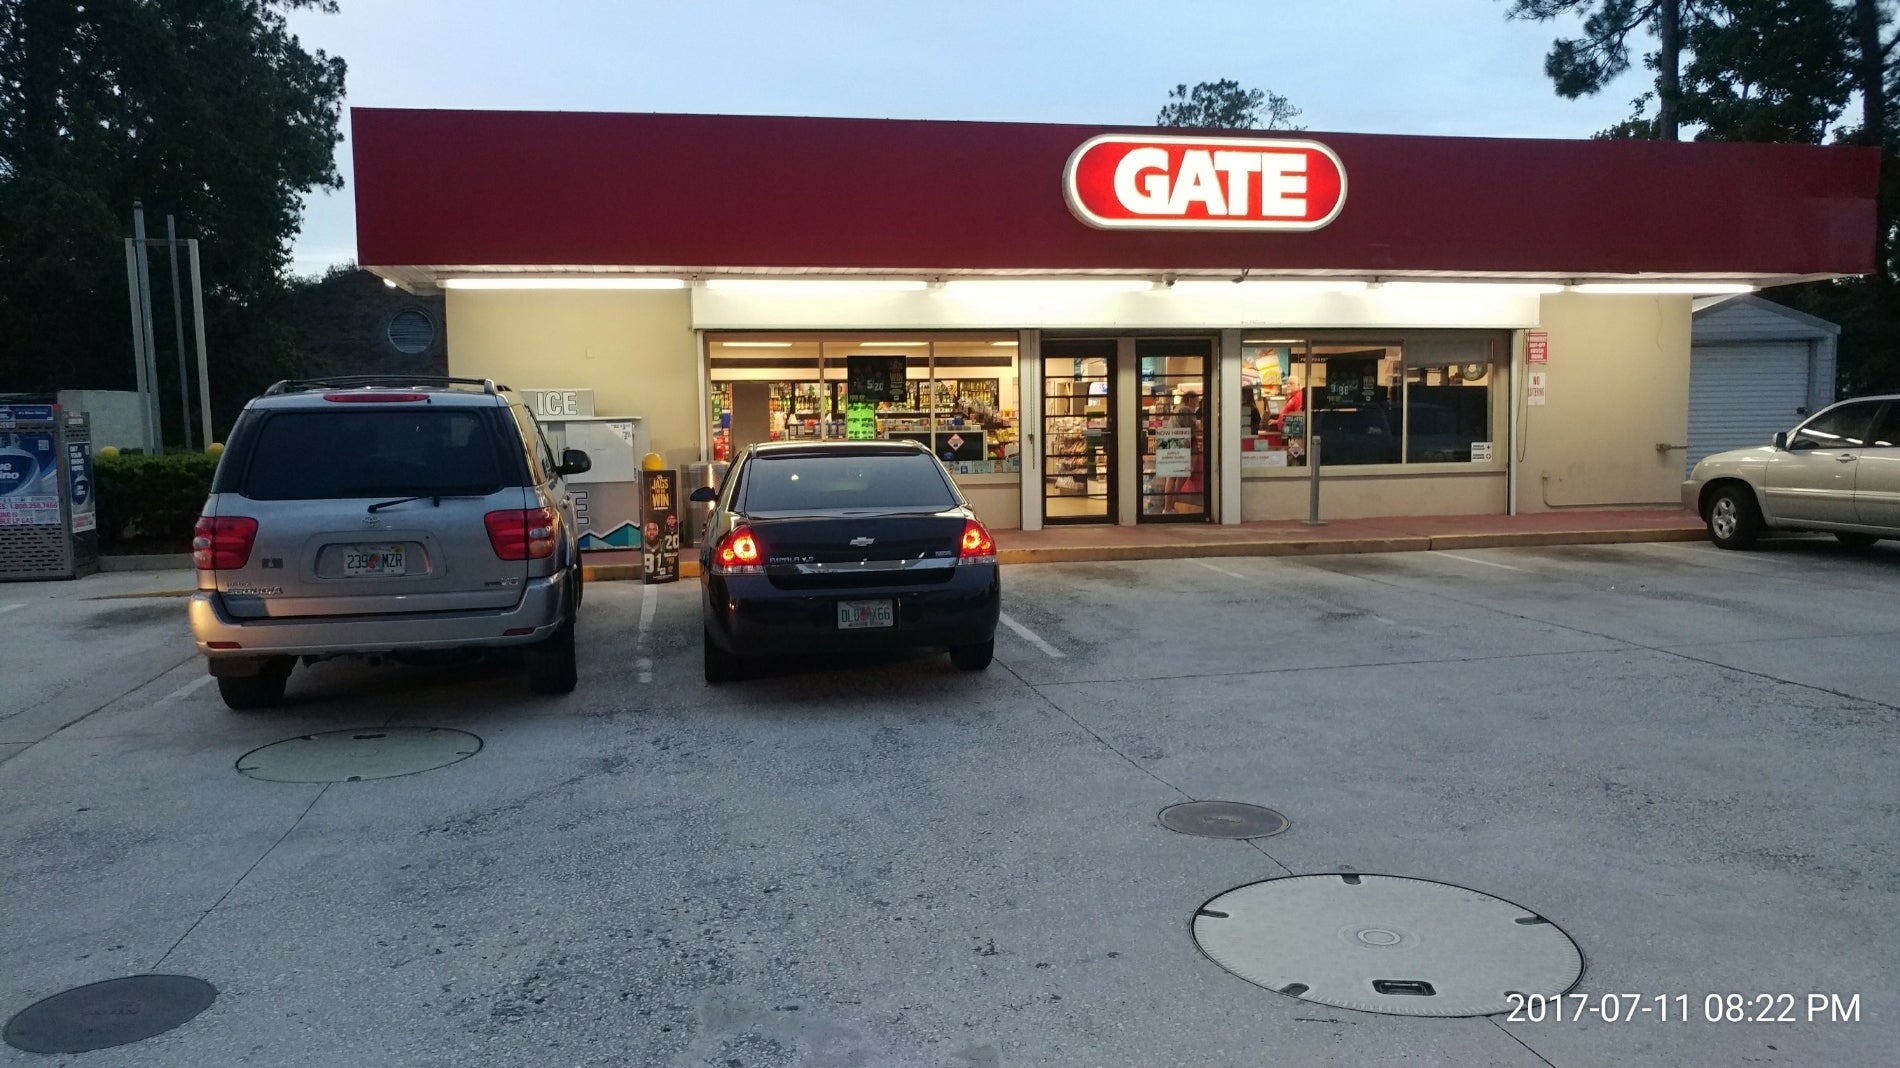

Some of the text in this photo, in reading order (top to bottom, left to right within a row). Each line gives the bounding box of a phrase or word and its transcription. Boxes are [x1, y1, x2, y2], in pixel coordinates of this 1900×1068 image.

[1114, 147, 1307, 216] GATE
[537, 391, 578, 416] ICE
[651, 478, 669, 490] JAGS
[652, 493, 669, 507] WIN
[346, 553, 403, 569] 239 MZR
